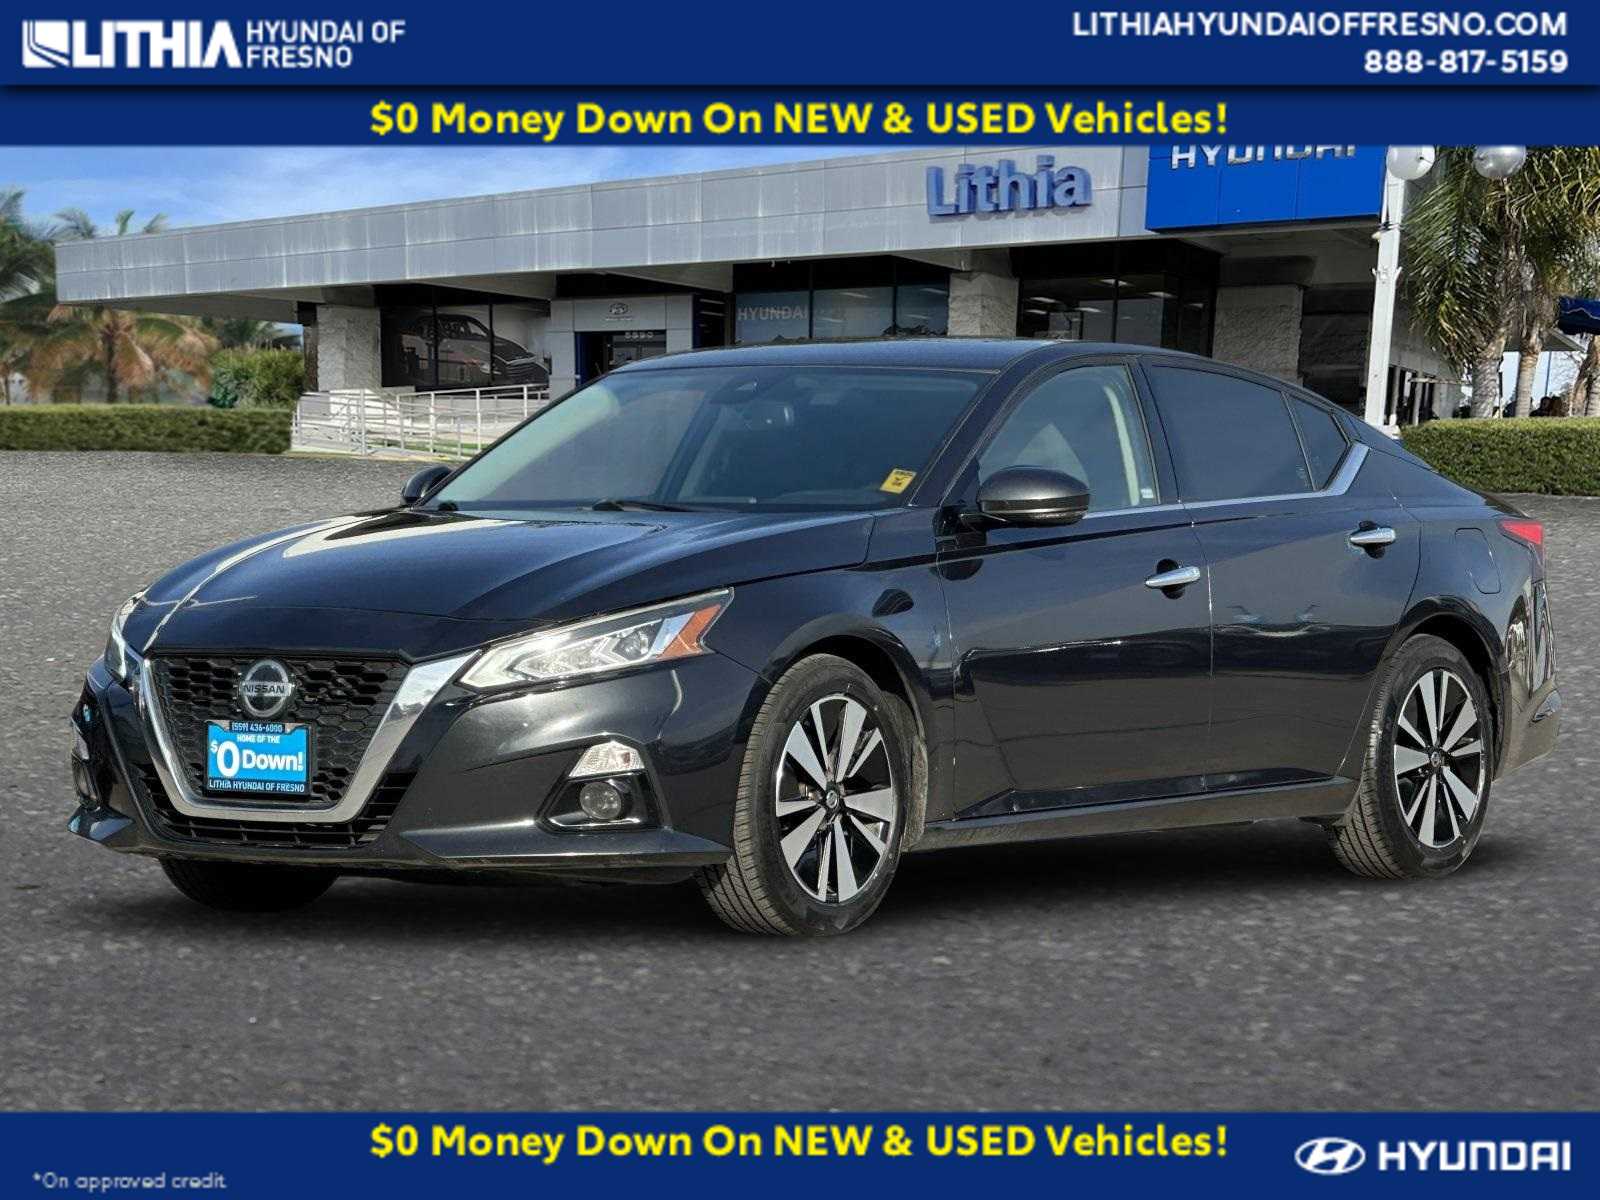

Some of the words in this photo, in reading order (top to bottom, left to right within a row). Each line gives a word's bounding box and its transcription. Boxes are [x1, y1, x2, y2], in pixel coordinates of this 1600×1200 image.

[926, 154, 1092, 216] Lithia
[737, 305, 808, 321] HYUNDAI
[243, 684, 285, 694] NISSAN
[236, 733, 256, 743] HOME
[257, 734, 266, 743] OF
[267, 734, 281, 744] THE
[242, 749, 305, 772] Down!
[208, 780, 231, 790] LITHIA
[233, 781, 264, 791] HYUNDAI
[265, 782, 275, 792] OF
[276, 783, 305, 793] FRESNO
